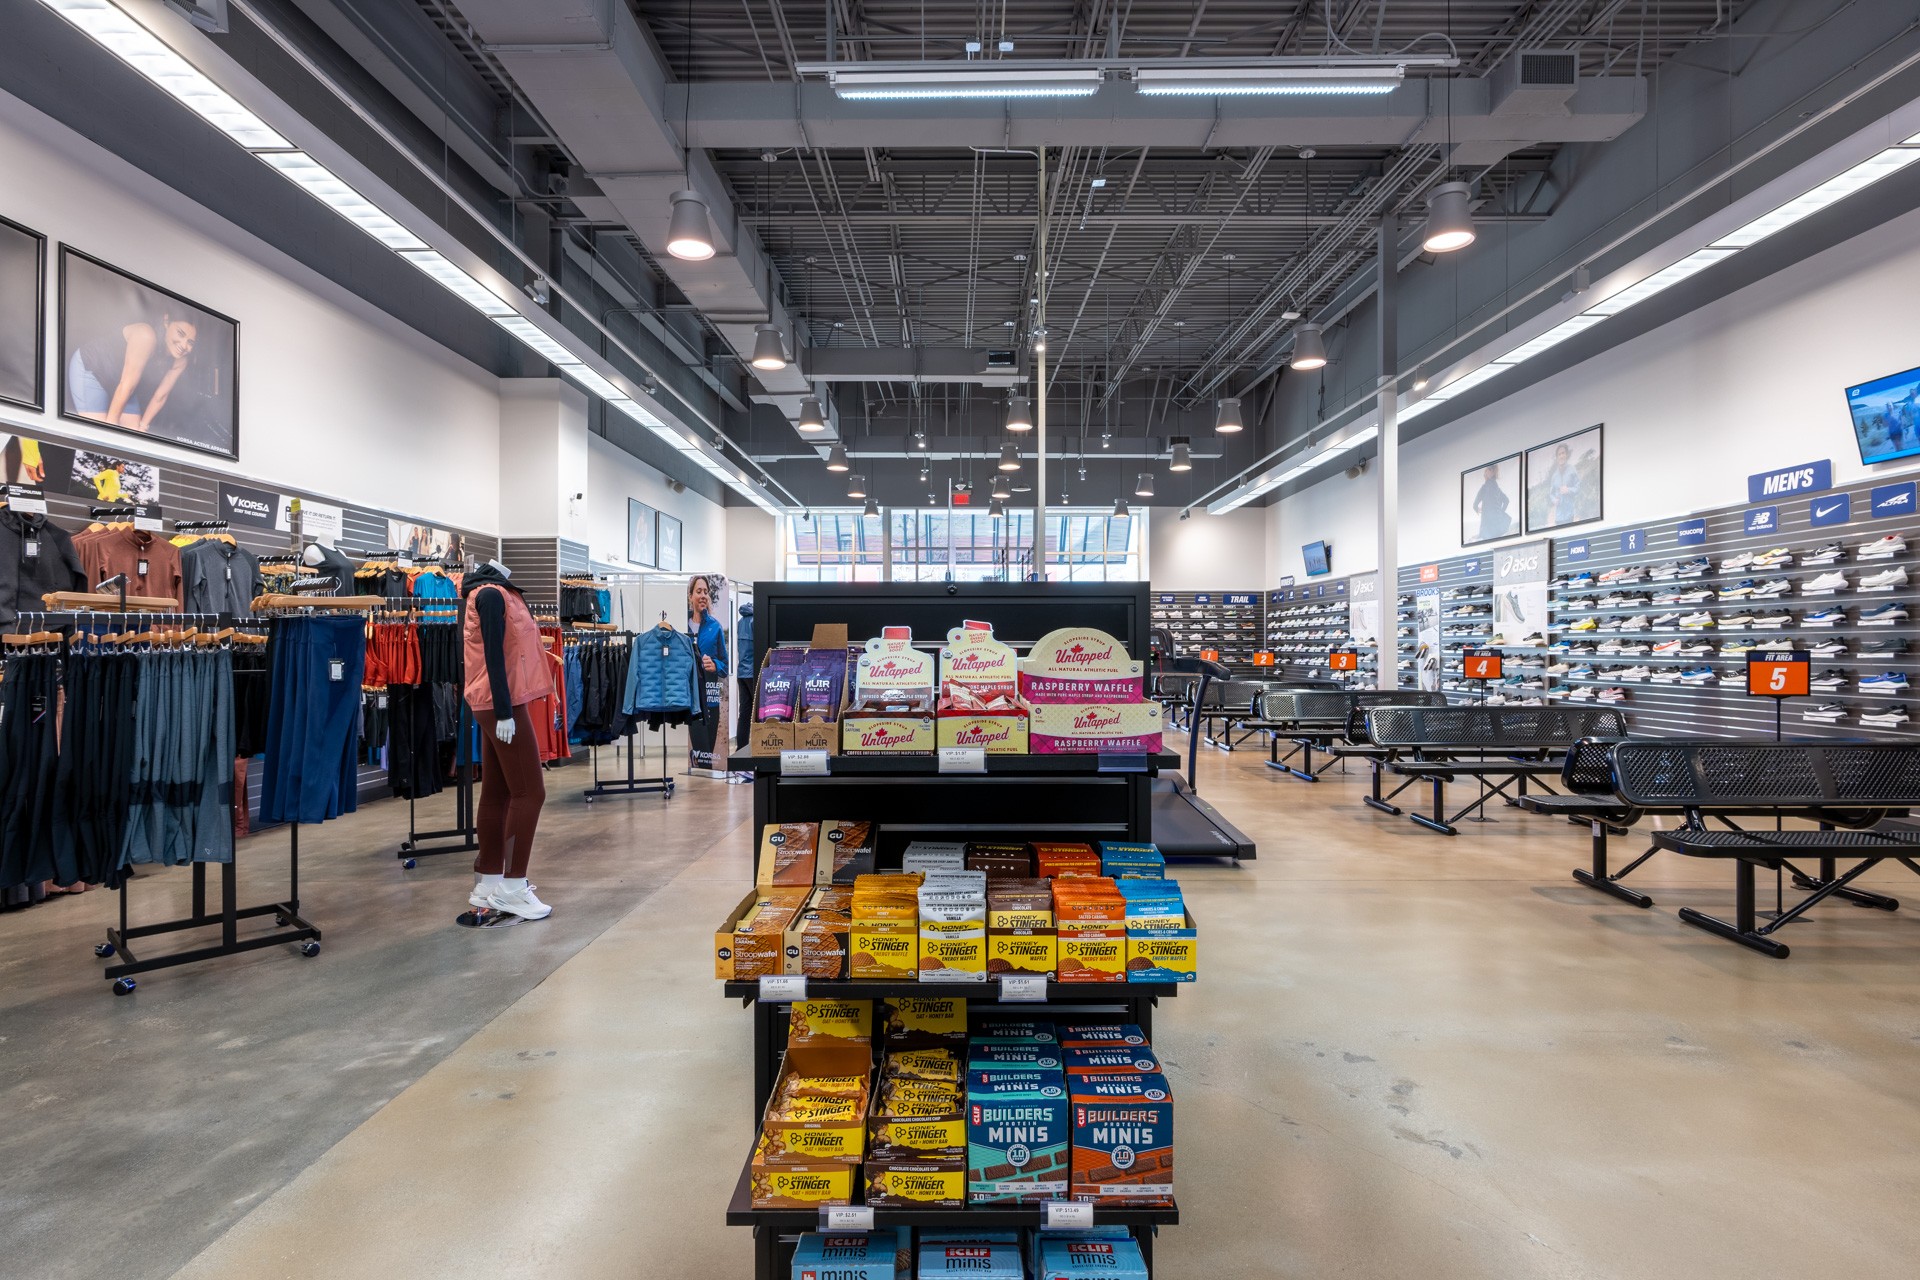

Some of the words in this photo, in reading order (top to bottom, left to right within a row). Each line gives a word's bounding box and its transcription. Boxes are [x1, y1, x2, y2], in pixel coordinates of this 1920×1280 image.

[1763, 468, 1814, 495] MEN'S
[238, 498, 270, 512] KORSA
[1679, 527, 1704, 536] saucony
[1570, 546, 1585, 554] HOKA
[1512, 556, 1538, 573] asics
[1416, 587, 1440, 597] BROOKS
[1064, 636, 1089, 645] SLOPESIDE
[1091, 637, 1106, 646] SYRUP
[1056, 646, 1113, 665] Untapped
[1207, 652, 1212, 660] 1
[1260, 655, 1267, 664] 2
[952, 654, 1006, 673] Untapped
[1339, 656, 1347, 668] 3
[870, 662, 923, 679] Untapped
[1476, 660, 1488, 675] 4
[1769, 667, 1788, 690] 5
[765, 680, 791, 690] MUIR
[805, 680, 830, 689] MUIR
[1031, 682, 1090, 692] RASPBERRY
[1094, 684, 1134, 692] WAFFLE
[1073, 712, 1121, 729] Untapped
[861, 729, 915, 748] Untapped
[956, 727, 1010, 746] Untapped
[761, 739, 784, 747] MUIR
[805, 739, 828, 747] MUIR
[1055, 739, 1104, 747] RASPBERRY
[1107, 739, 1141, 747] WAFFLE
[870, 942, 910, 951] STINGER
[938, 945, 978, 956] STINGER
[1008, 946, 1049, 955] STINGER
[1078, 946, 1118, 956] STINGER
[1149, 945, 1188, 955] STINGER
[735, 950, 778, 958] Stroopwafel
[911, 1001, 954, 1013] STINGER
[818, 1008, 860, 1018] STINGER
[1081, 1032, 1123, 1040] MINIS
[912, 1059, 954, 1071] STINGER
[1088, 1056, 1132, 1065] MINIS
[989, 1073, 1042, 1082] BUILDERS
[993, 1083, 1039, 1092] MINIS
[1095, 1085, 1142, 1094] MINIS
[807, 1105, 852, 1118] STINGER
[972, 1106, 981, 1124] CLIF
[983, 1108, 1053, 1123] BUILDERS
[1088, 1110, 1159, 1124] BUILDERS
[907, 1129, 947, 1139] STINGER
[988, 1126, 1048, 1143] MINIS
[1093, 1127, 1153, 1144] MINIS
[802, 1136, 844, 1146] STINGER
[789, 1180, 831, 1190] STINGER
[903, 1180, 945, 1190] STINGER
[834, 1238, 866, 1246] CLIF
[822, 1247, 867, 1258] minis
[955, 1248, 988, 1256] CLIF
[946, 1258, 991, 1269] minis
[1070, 1253, 1116, 1265] minis
